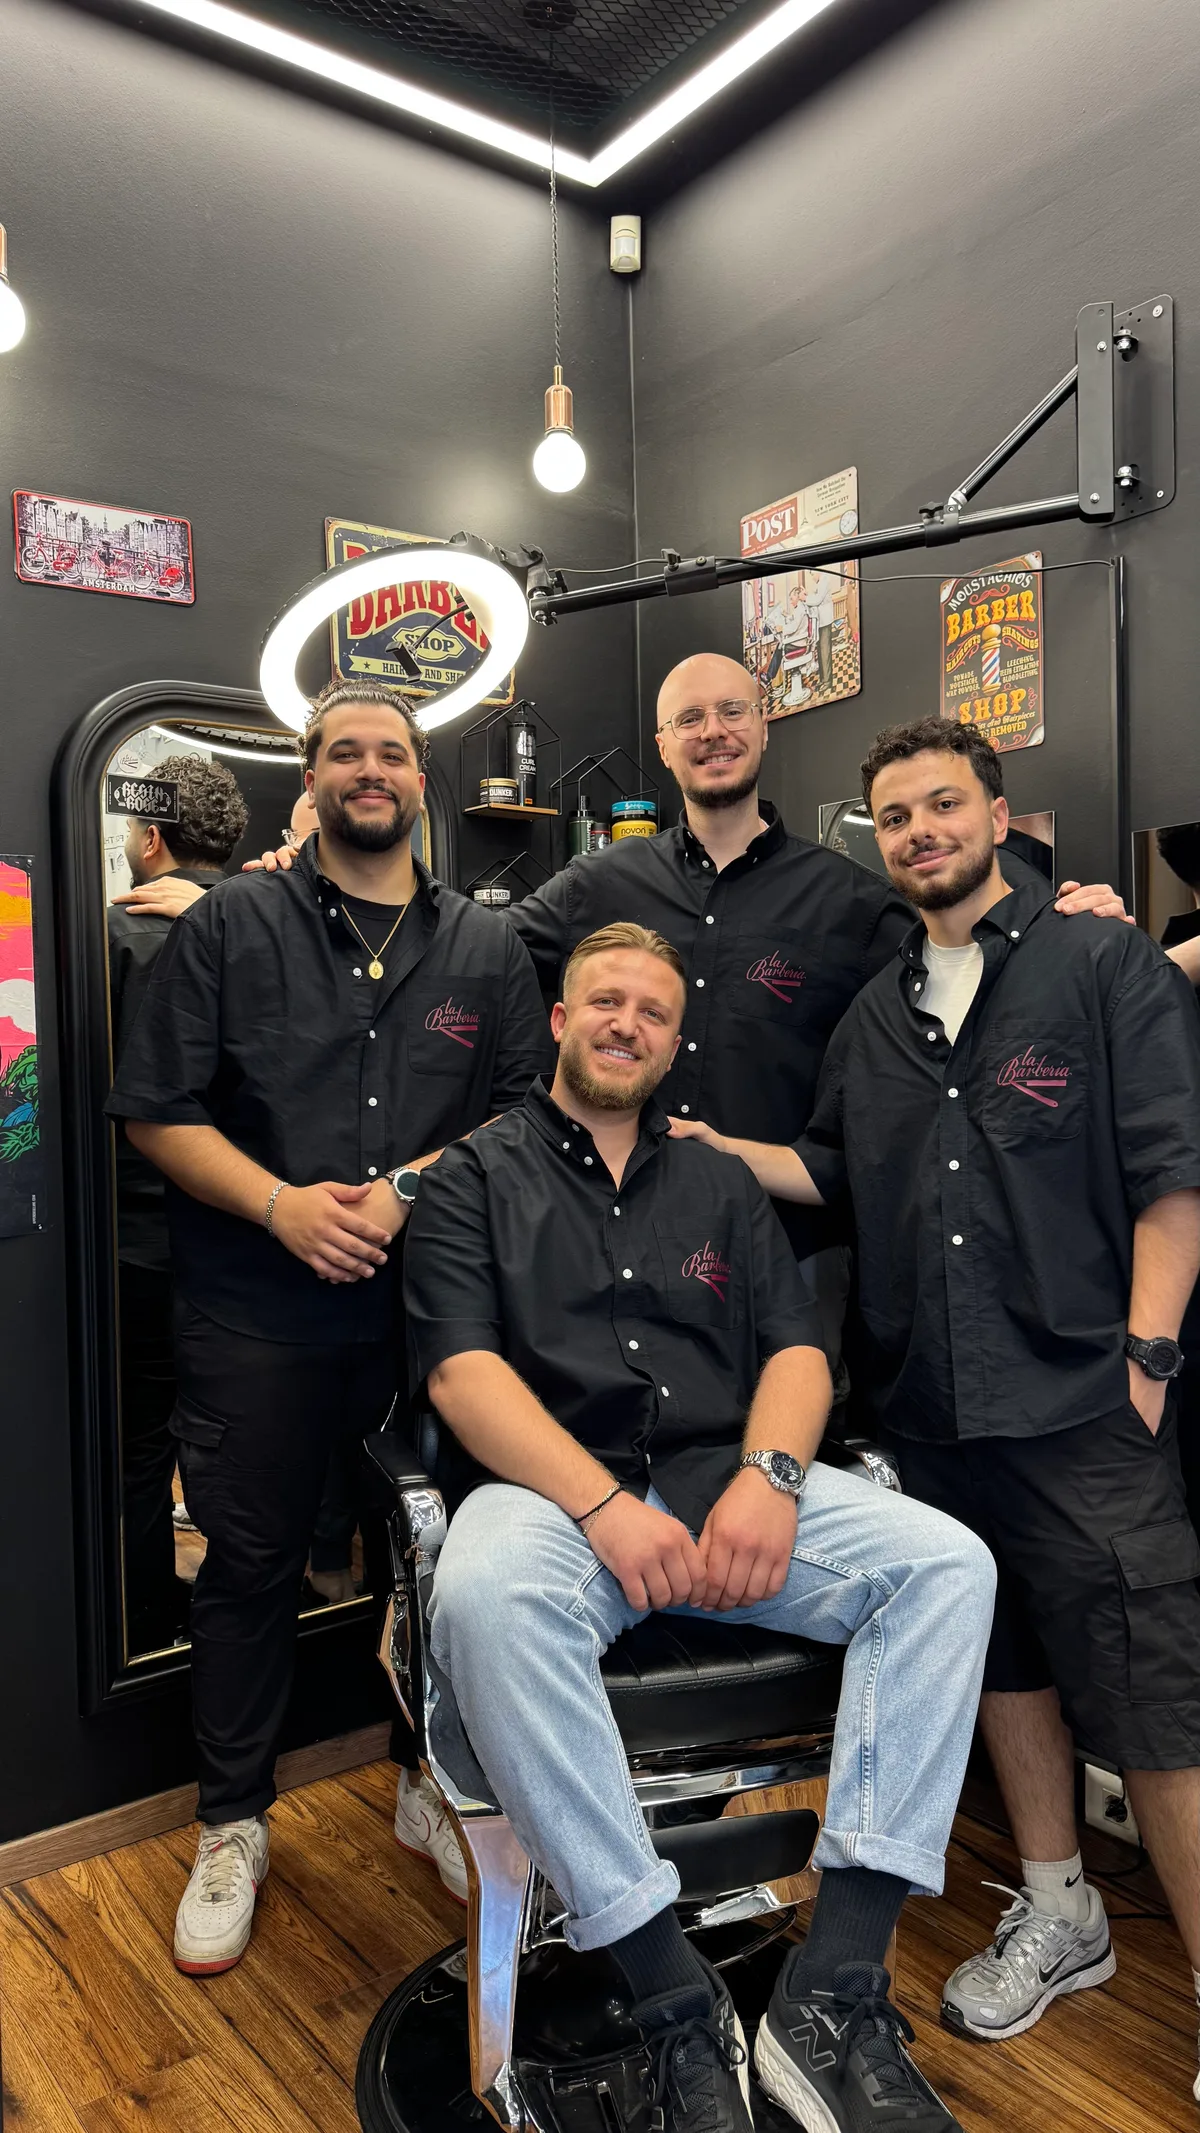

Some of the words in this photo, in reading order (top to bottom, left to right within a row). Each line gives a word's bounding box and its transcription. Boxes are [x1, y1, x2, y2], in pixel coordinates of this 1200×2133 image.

[741, 506, 796, 551] POST
[82, 578, 136, 593] AMSTERDAM
[948, 571, 1034, 611] MOUSTACHIOS
[946, 589, 1037, 646] BARBER
[404, 633, 455, 653] SHOP
[946, 635, 981, 672] HAIRCUTS
[1001, 626, 1039, 649] SHAVINGS
[424, 668, 442, 680] AND
[958, 688, 1026, 724] SHOP
[990, 721, 1027, 737] REMOVED
[520, 757, 536, 766] CURL
[746, 956, 807, 981] Barberia
[769, 950, 782, 968] la
[444, 996, 457, 1015] la
[425, 1004, 480, 1030] Barberia
[1021, 1044, 1038, 1066] la
[997, 1053, 1072, 1086] Barberia
[703, 1240, 716, 1261] la
